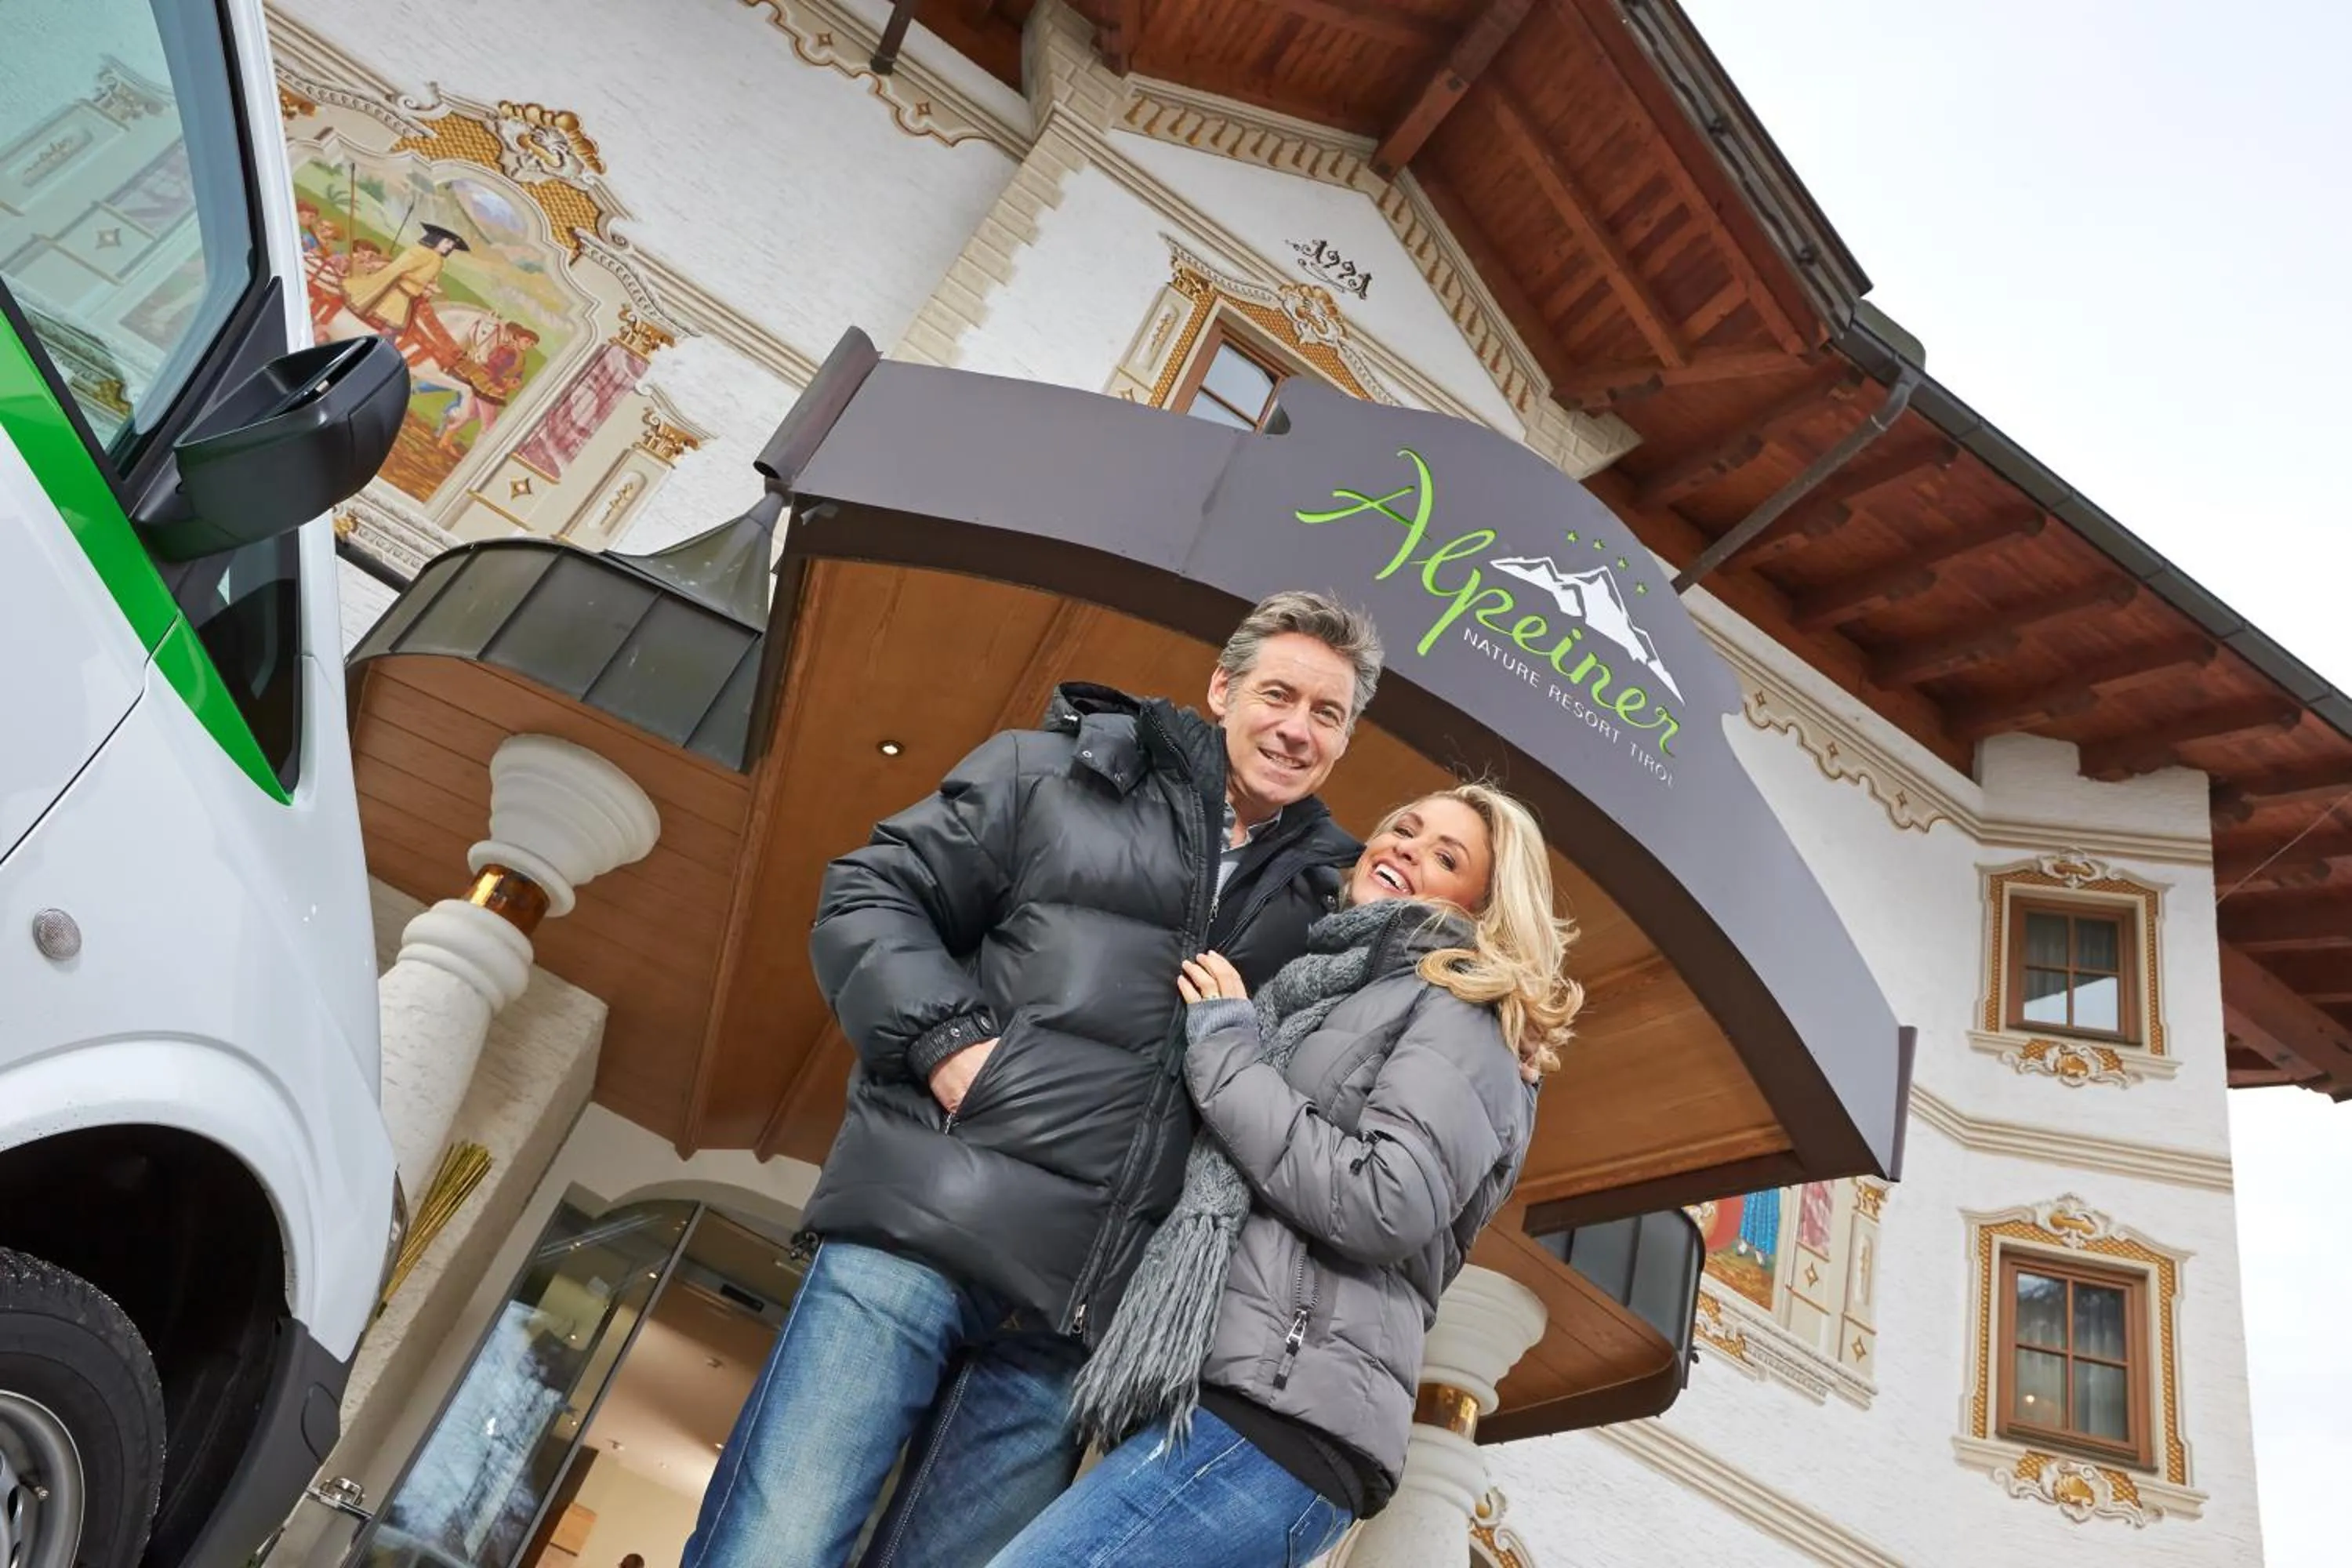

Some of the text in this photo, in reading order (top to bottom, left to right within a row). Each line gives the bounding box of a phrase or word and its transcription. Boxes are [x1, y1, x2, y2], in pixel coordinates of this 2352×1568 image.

[1305, 239, 1372, 301] 1991
[1294, 447, 1681, 759] Alpeiner
[1463, 627, 1541, 688] NATURE
[1548, 684, 1621, 744] RESORT
